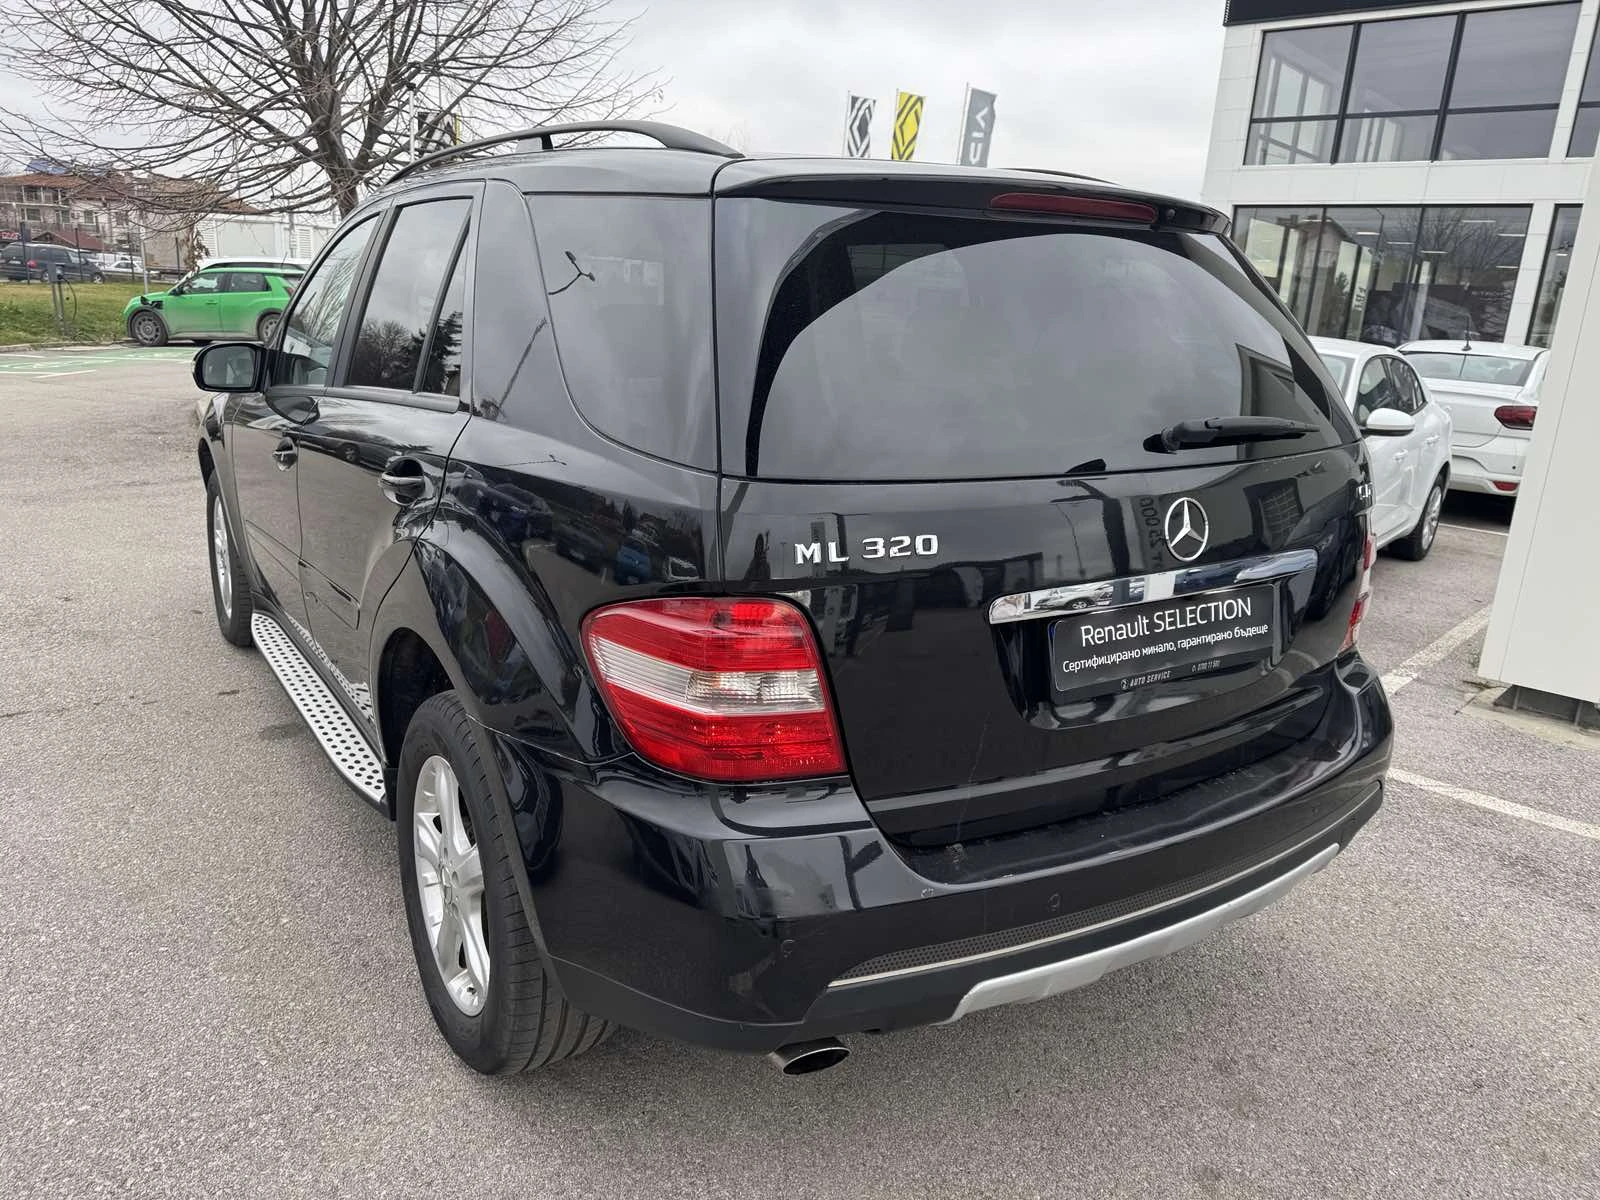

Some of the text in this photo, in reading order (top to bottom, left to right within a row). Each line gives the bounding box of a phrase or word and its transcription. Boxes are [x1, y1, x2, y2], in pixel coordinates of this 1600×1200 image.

[794, 534, 939, 565] ML 320
[1080, 597, 1252, 647] Renault SELECTION
[1062, 624, 1269, 673] Сертифицирано минало, гарантирано бъдеще
[1147, 670, 1171, 684] SERVICE
